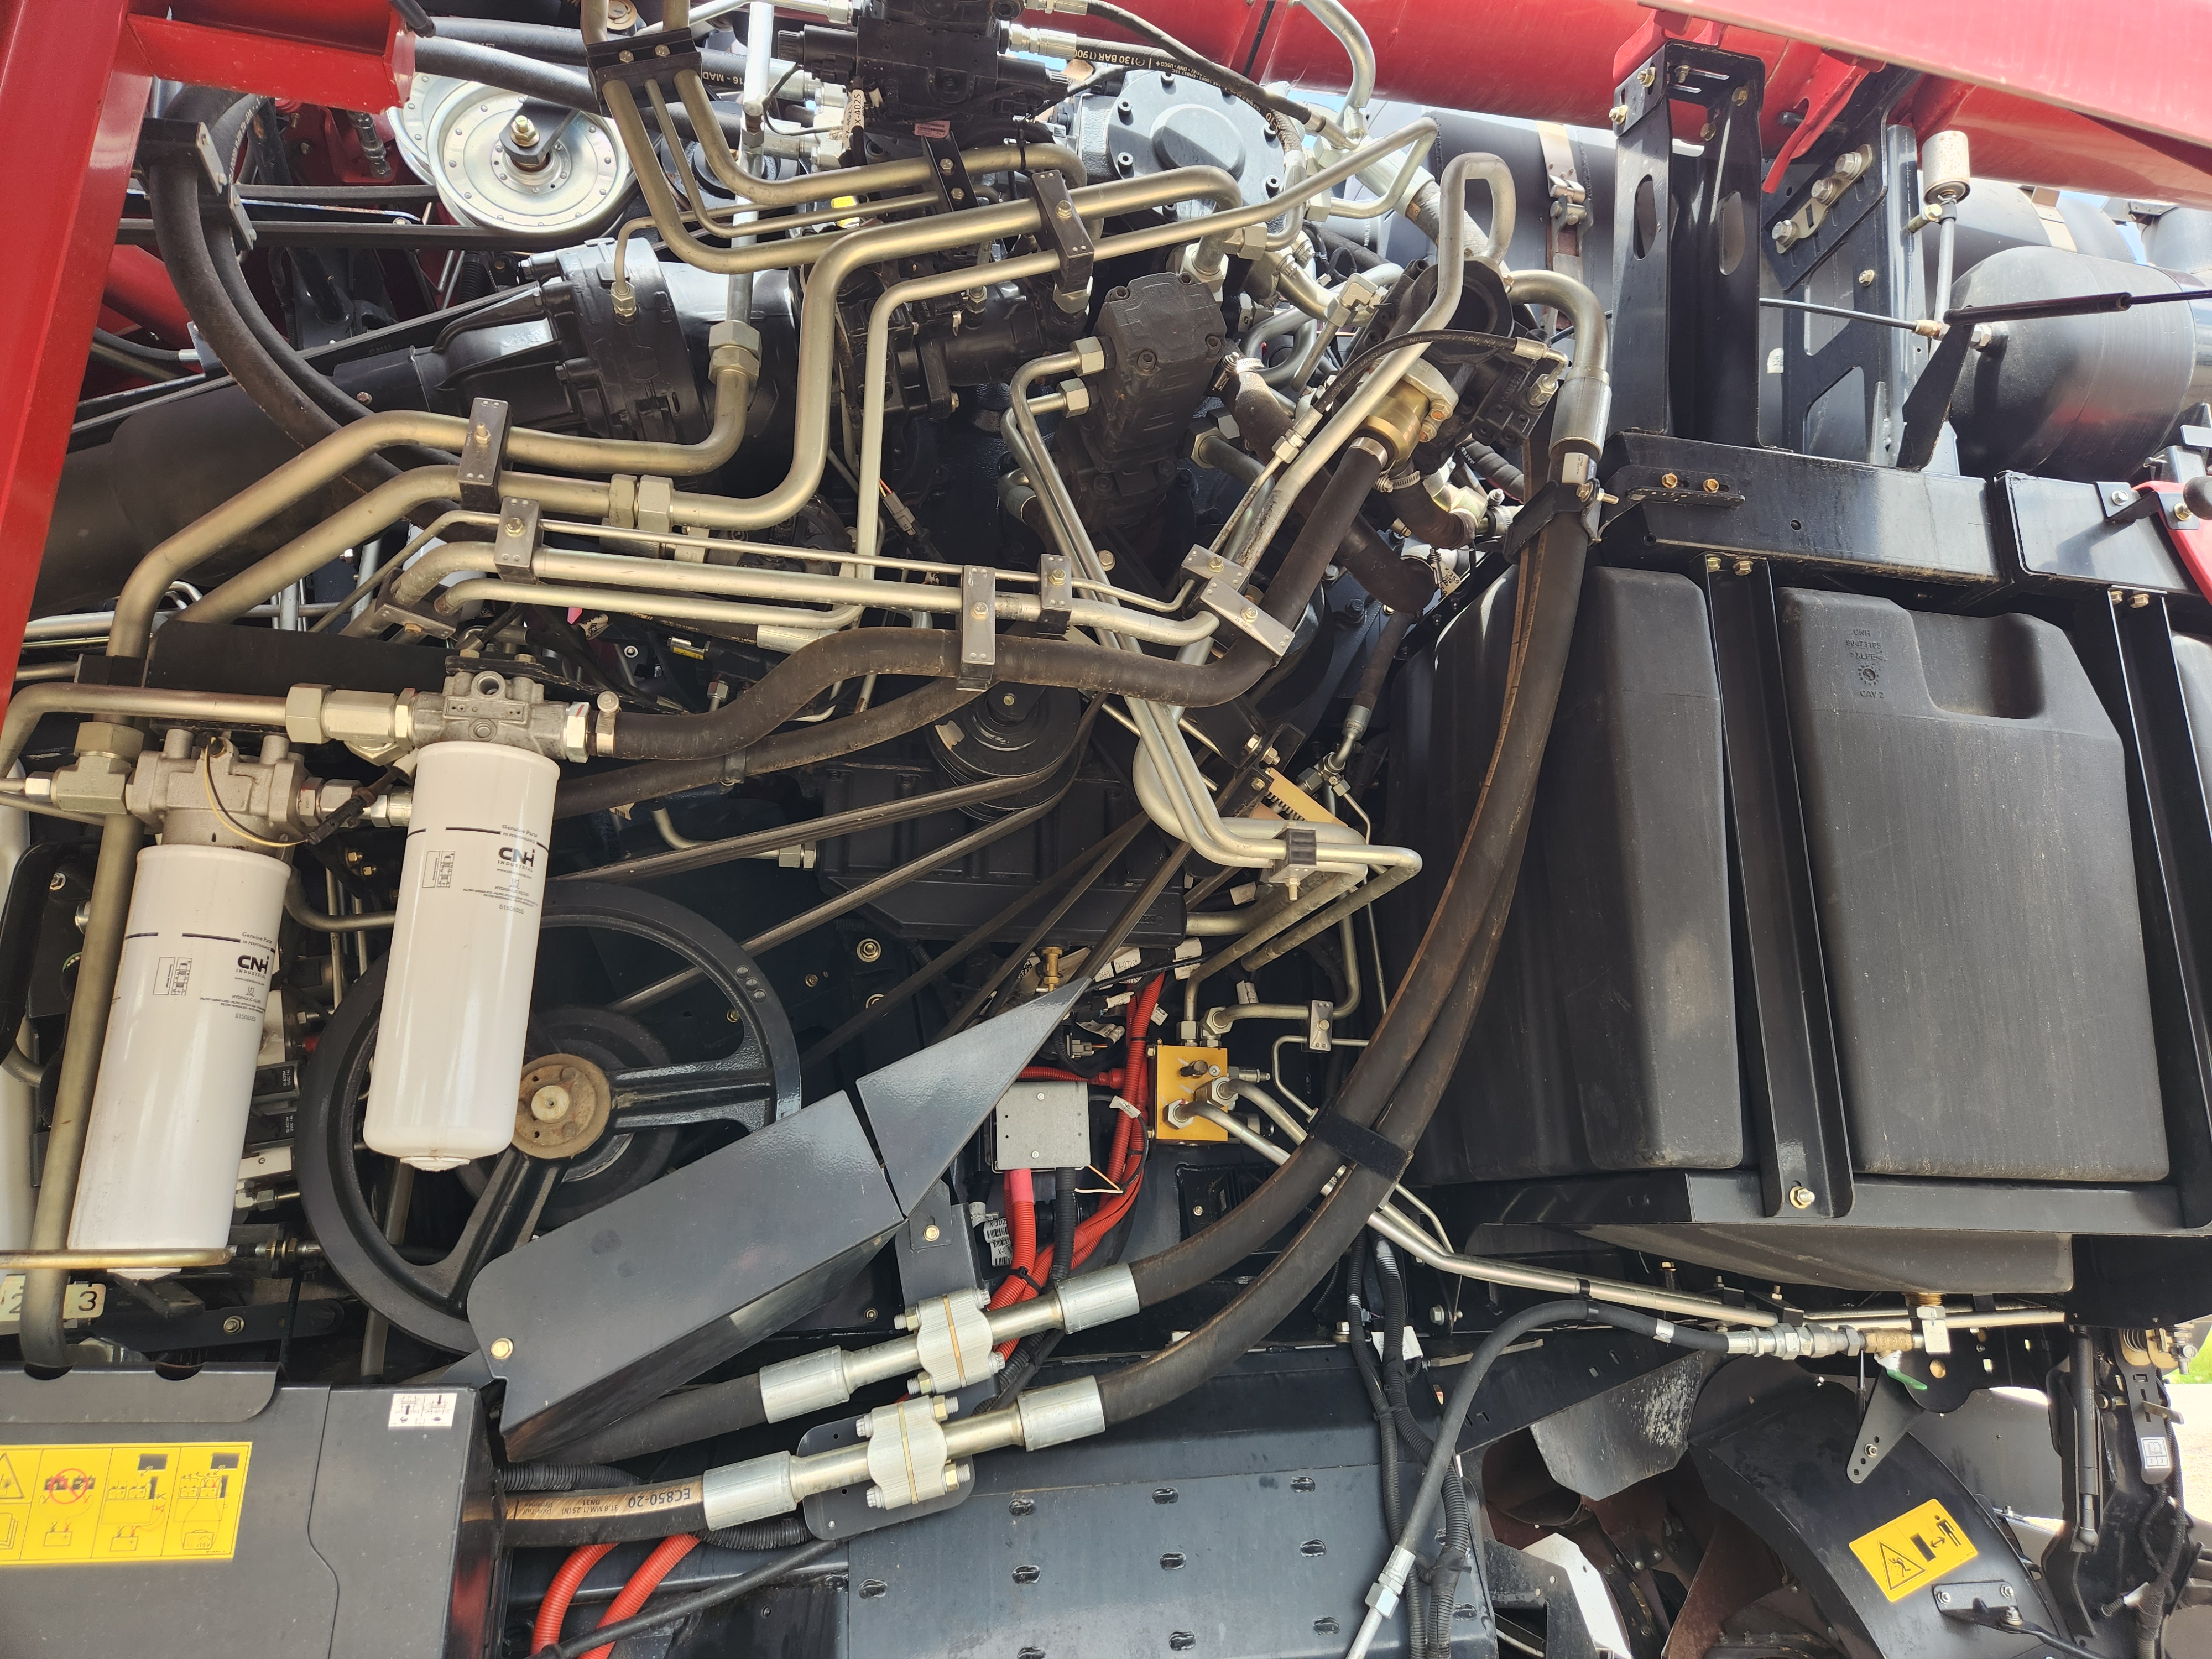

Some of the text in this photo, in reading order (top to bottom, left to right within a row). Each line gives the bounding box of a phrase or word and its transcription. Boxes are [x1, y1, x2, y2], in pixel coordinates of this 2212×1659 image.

[1098, 53, 1117, 62] BAR
[1119, 55, 1134, 65] 130
[702, 71, 724, 82] MAD
[1360, 349, 1381, 367] MSHA
[1444, 566, 1459, 584] X-159
[502, 824, 525, 833] Genuine
[509, 833, 535, 844] PERFORMANCE
[498, 860, 533, 872] INDUSTRIAL
[242, 932, 263, 941] Genuine
[236, 968, 267, 979] INDUSTRIAL
[78, 1291, 97, 1311] 3
[628, 1488, 691, 1508] EC850-20
